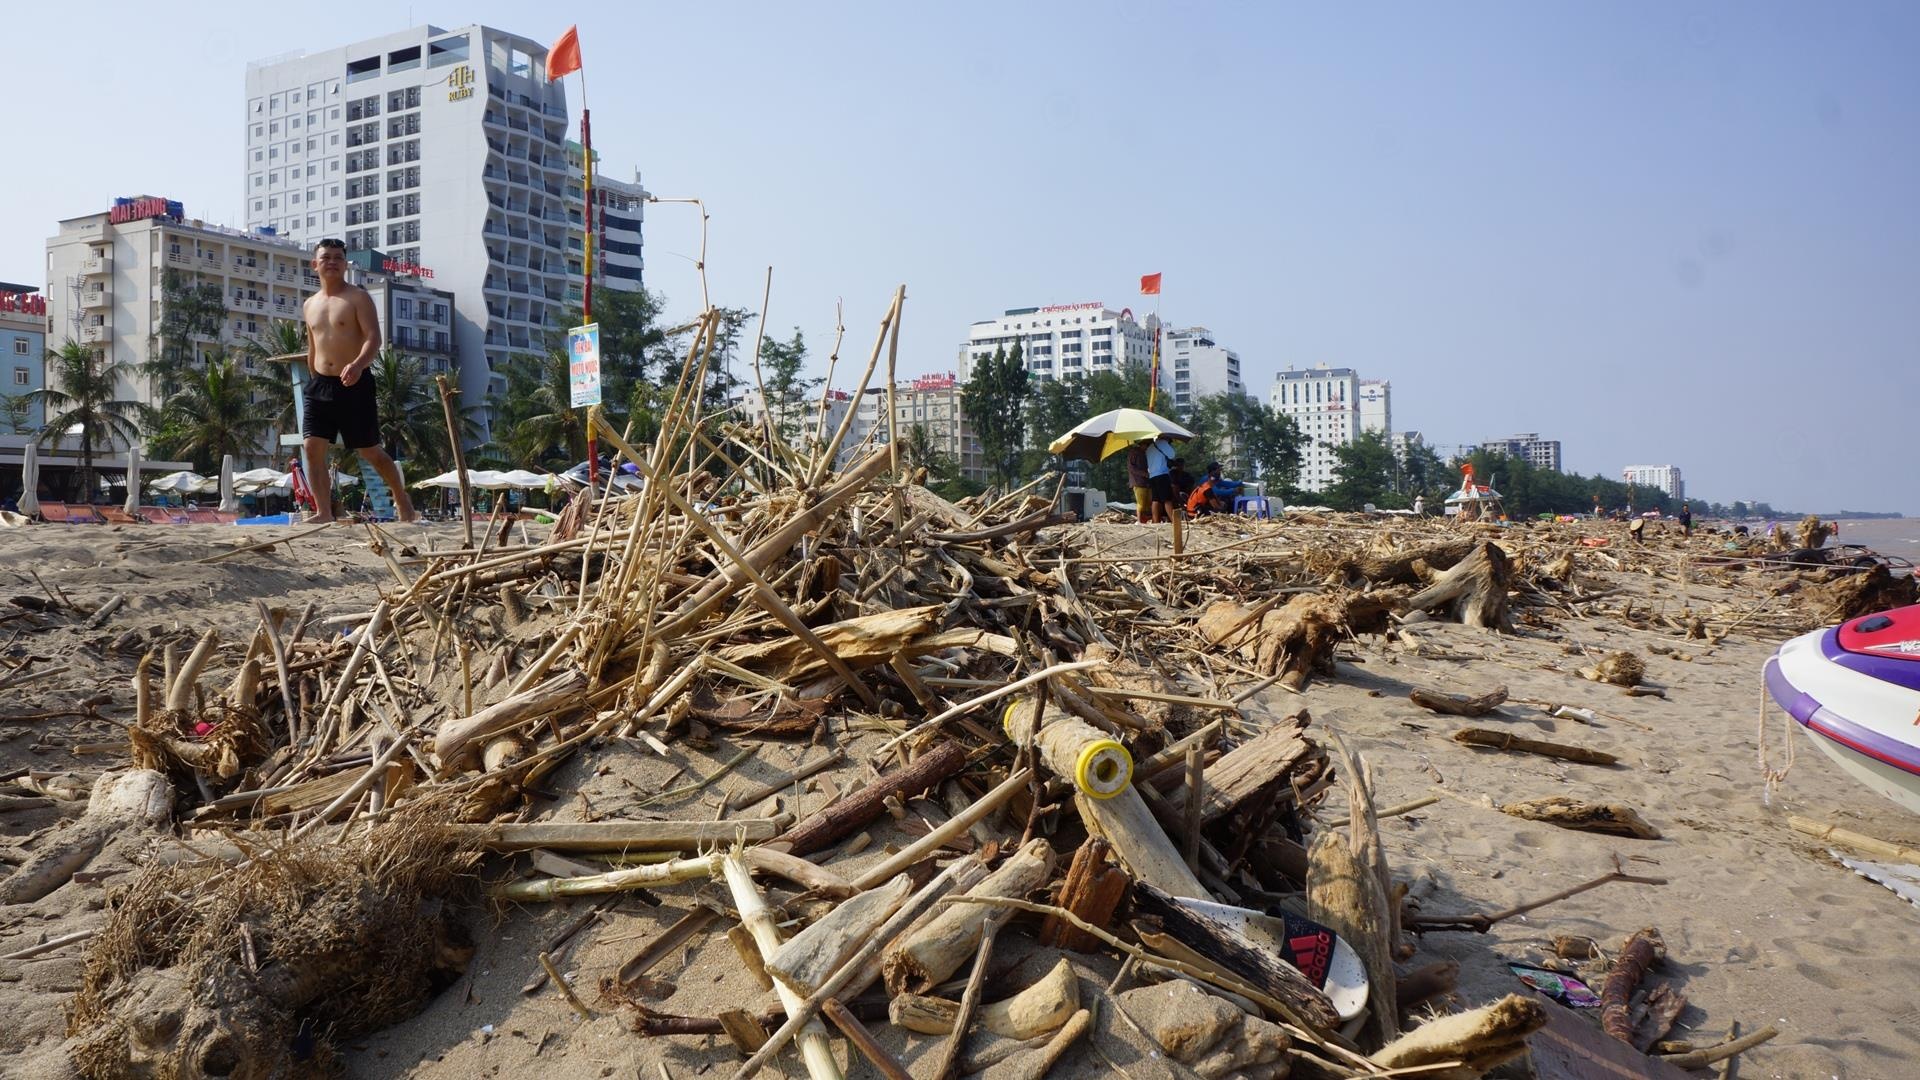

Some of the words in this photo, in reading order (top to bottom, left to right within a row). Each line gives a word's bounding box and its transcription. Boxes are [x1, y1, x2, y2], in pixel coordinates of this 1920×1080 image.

[448, 87, 474, 102] RUBY
[111, 203, 130, 224] MAI
[411, 264, 434, 279] HOTEL
